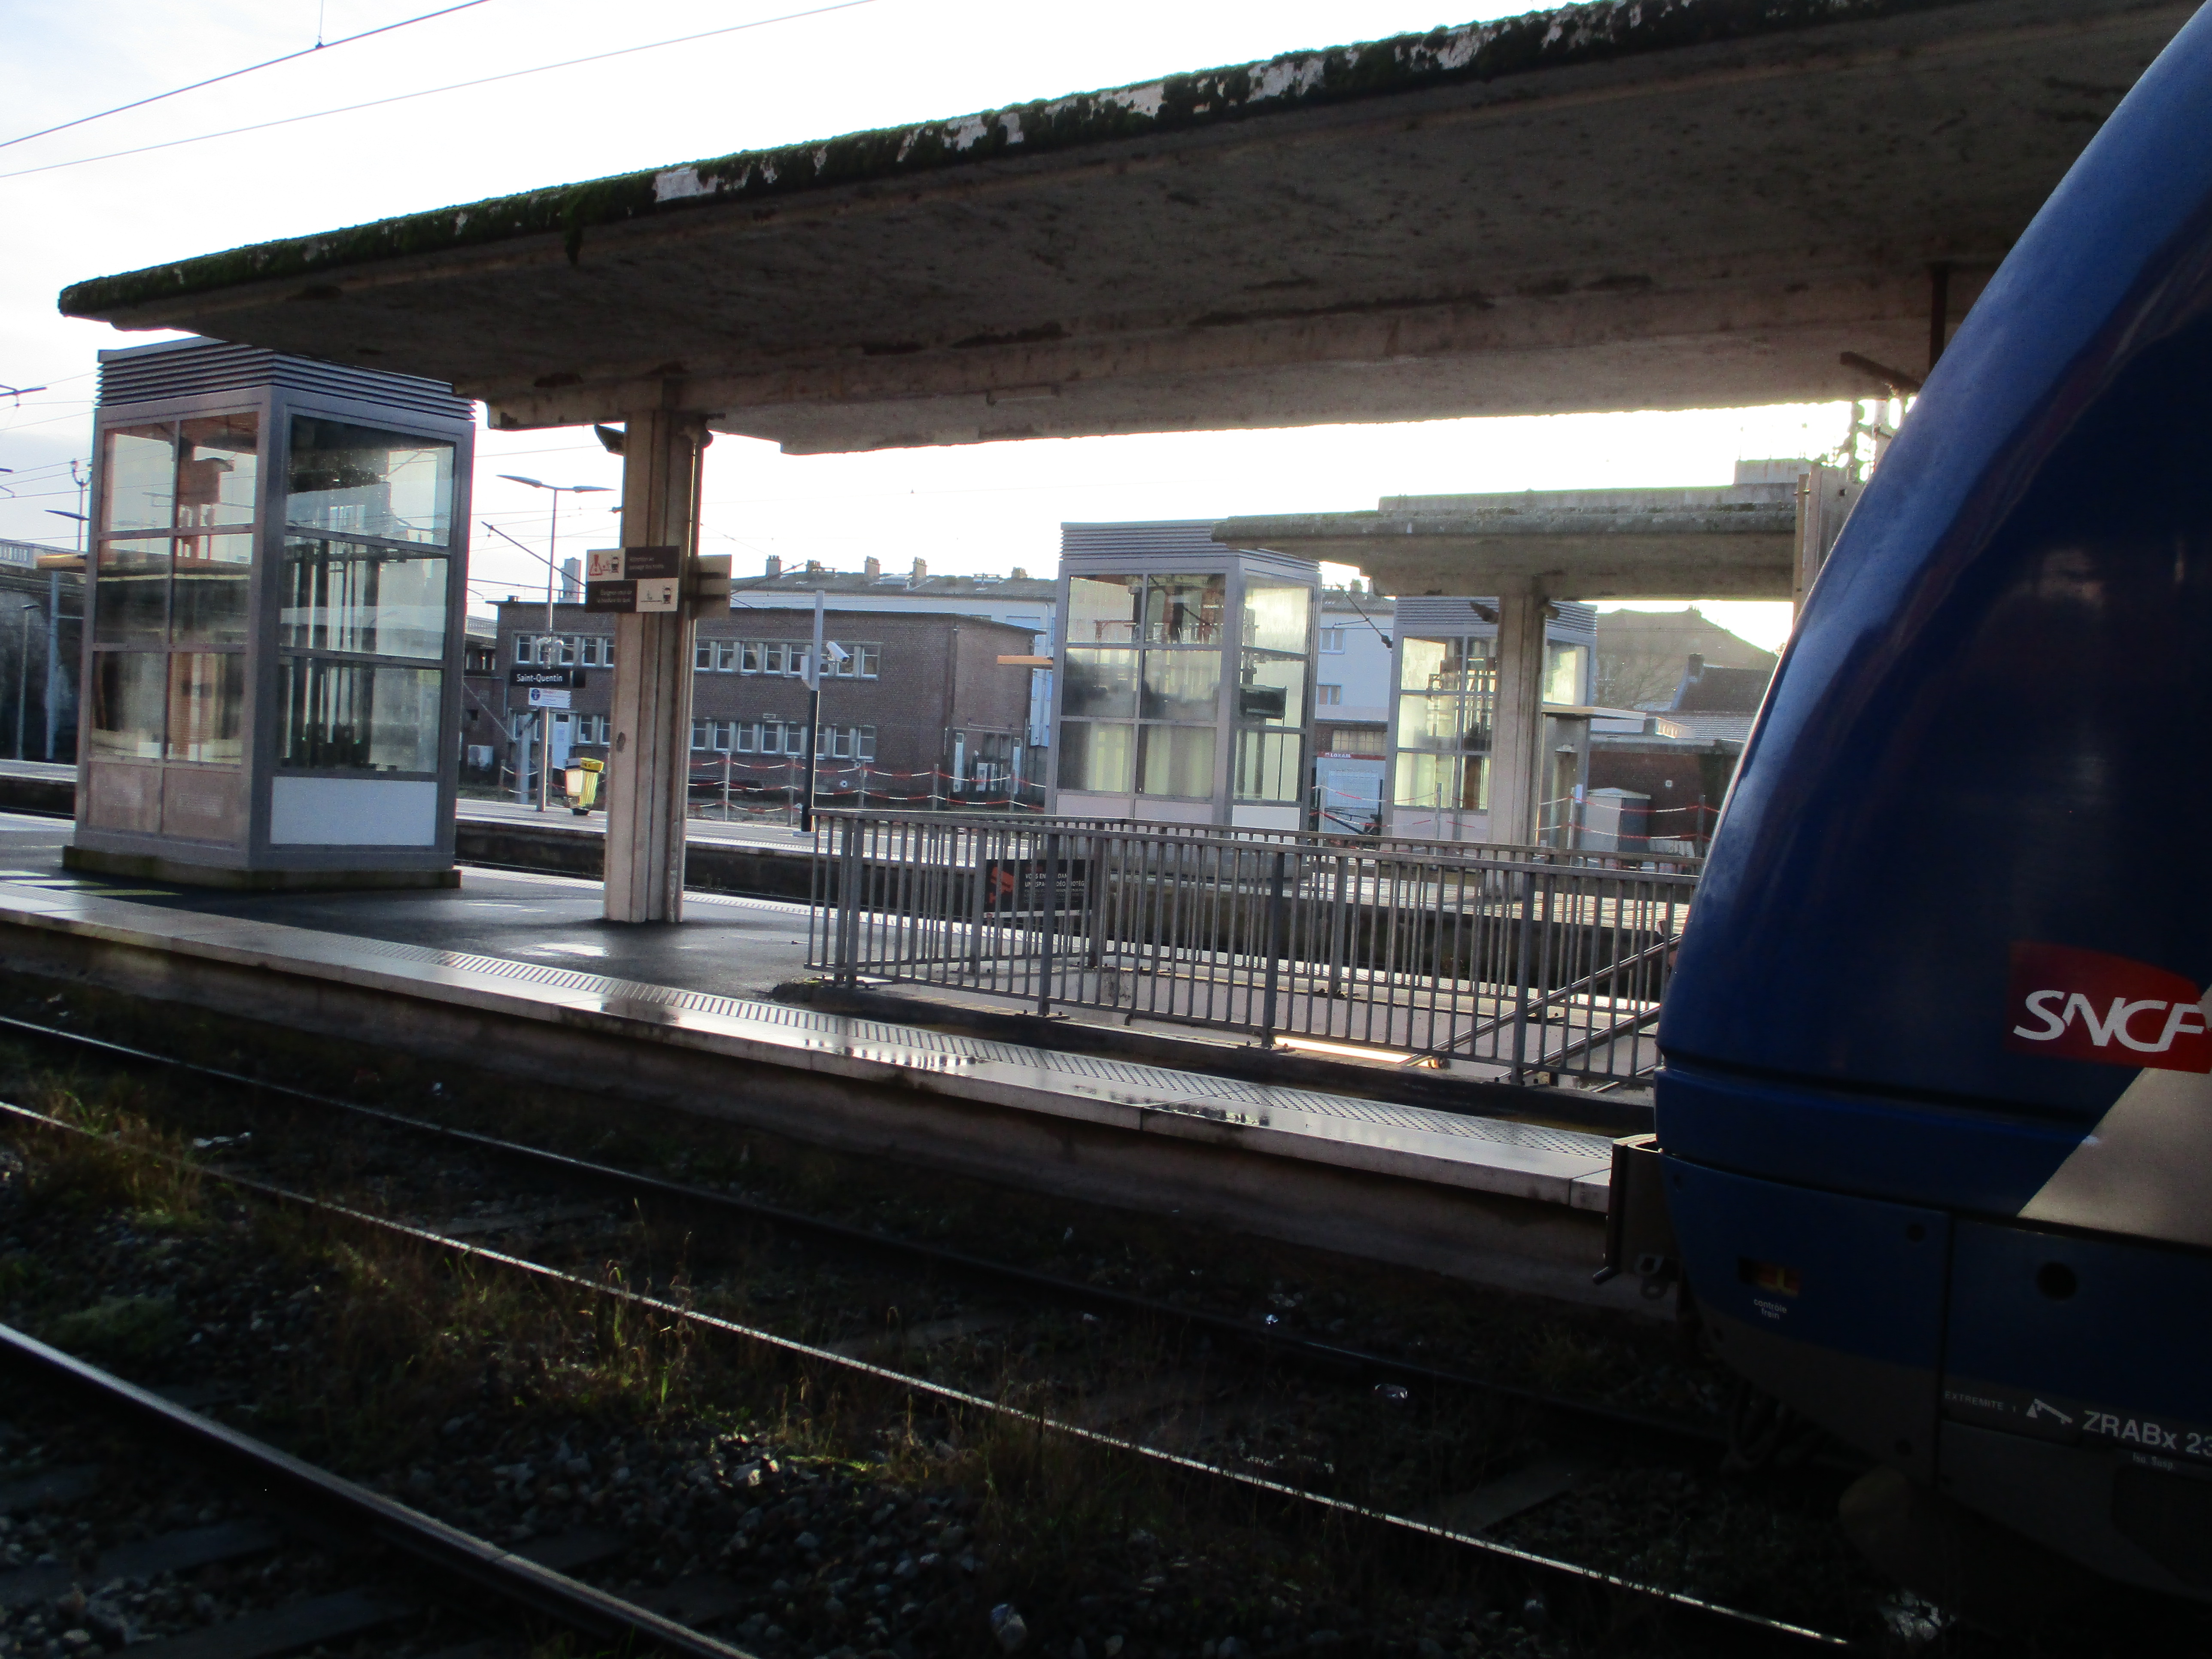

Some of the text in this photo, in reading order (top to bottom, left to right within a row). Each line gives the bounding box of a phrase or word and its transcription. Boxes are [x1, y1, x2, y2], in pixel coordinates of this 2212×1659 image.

[517, 674, 563, 683] Saint-Quentin
[2013, 990, 2204, 1052] SNCF
[1753, 1299, 1787, 1313] contrôle
[1761, 1308, 1780, 1320] frein
[1945, 1391, 2004, 1411] EXTREMITE
[2082, 1410, 2177, 1450] ZRABx
